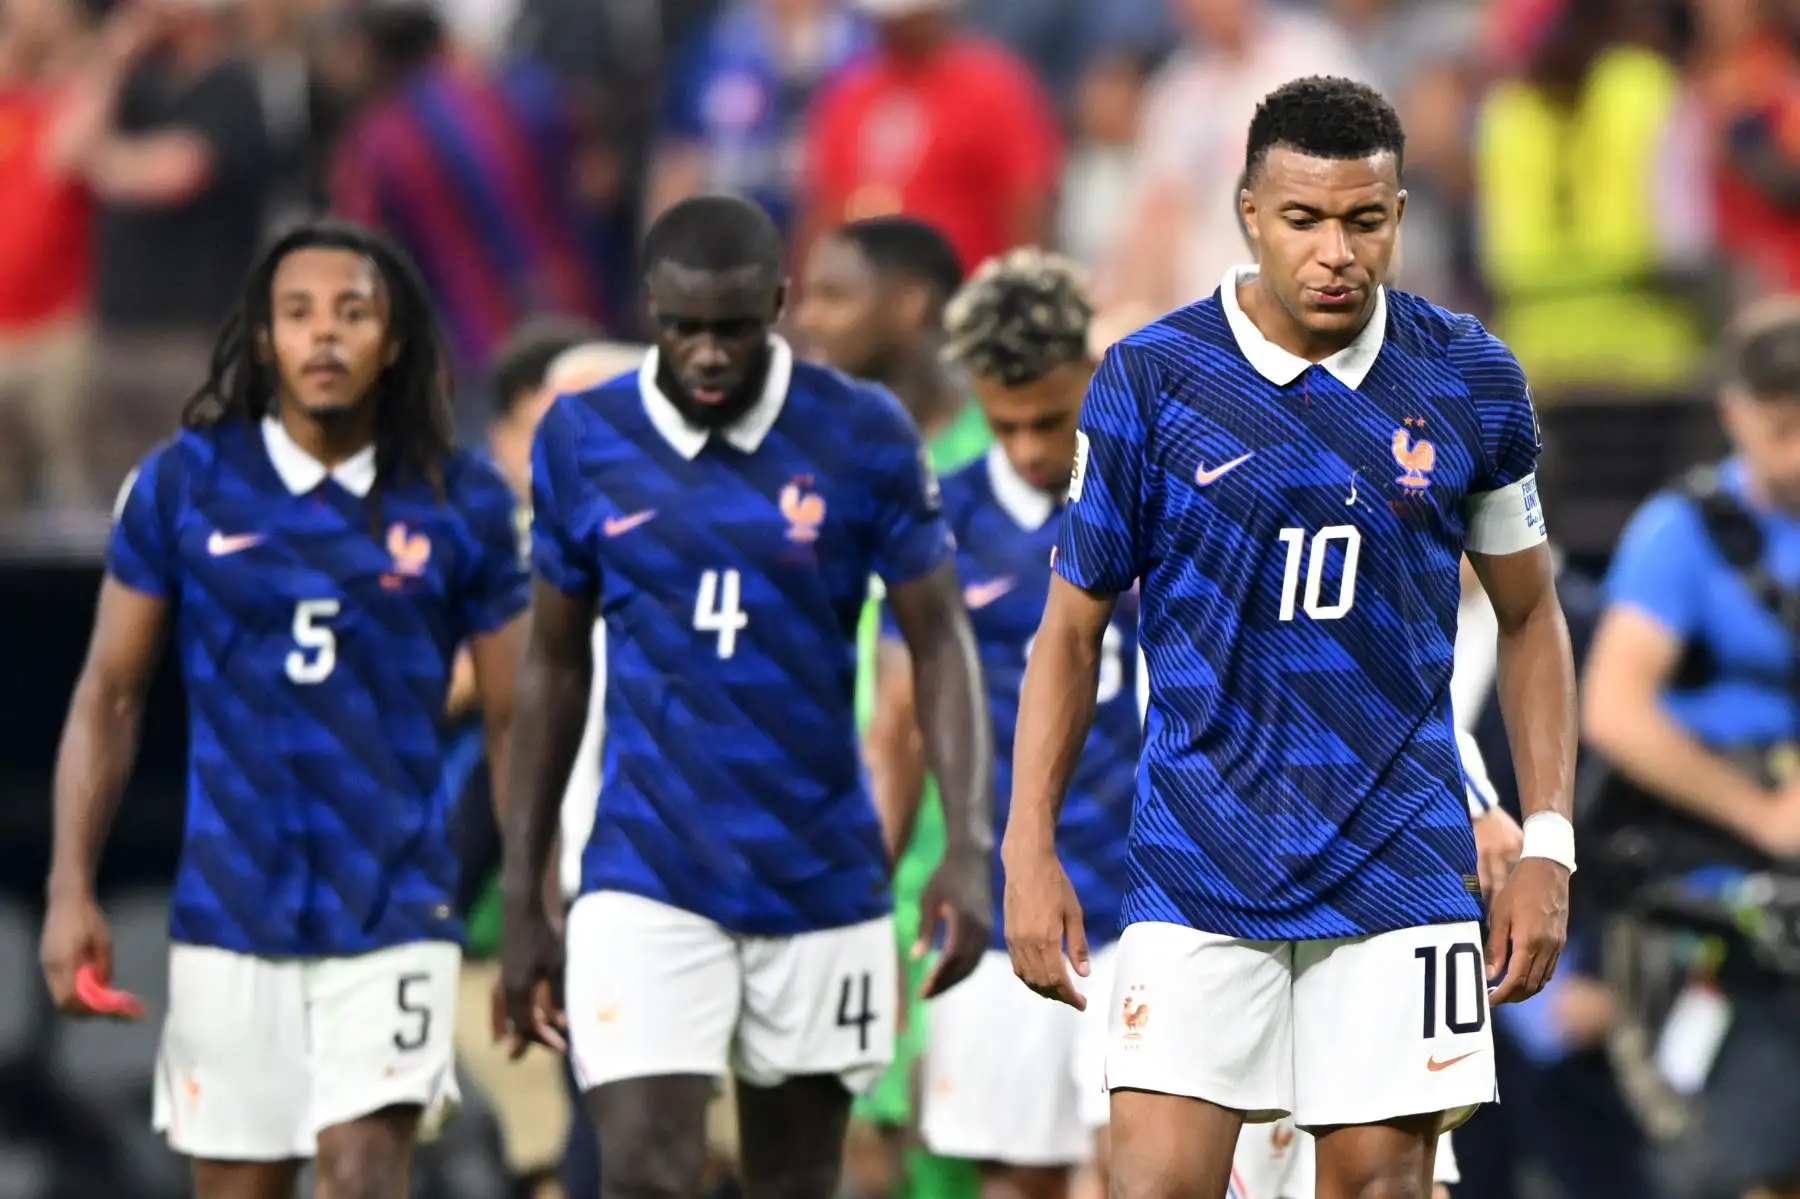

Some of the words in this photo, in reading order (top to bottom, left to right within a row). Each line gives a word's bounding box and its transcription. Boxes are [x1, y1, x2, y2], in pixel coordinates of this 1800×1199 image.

[693, 569, 748, 660] 4
[1279, 525, 1361, 621] 10
[284, 598, 339, 684] 5
[393, 973, 431, 1051] 5
[836, 970, 877, 1051] 4
[1415, 942, 1485, 1039] 10
